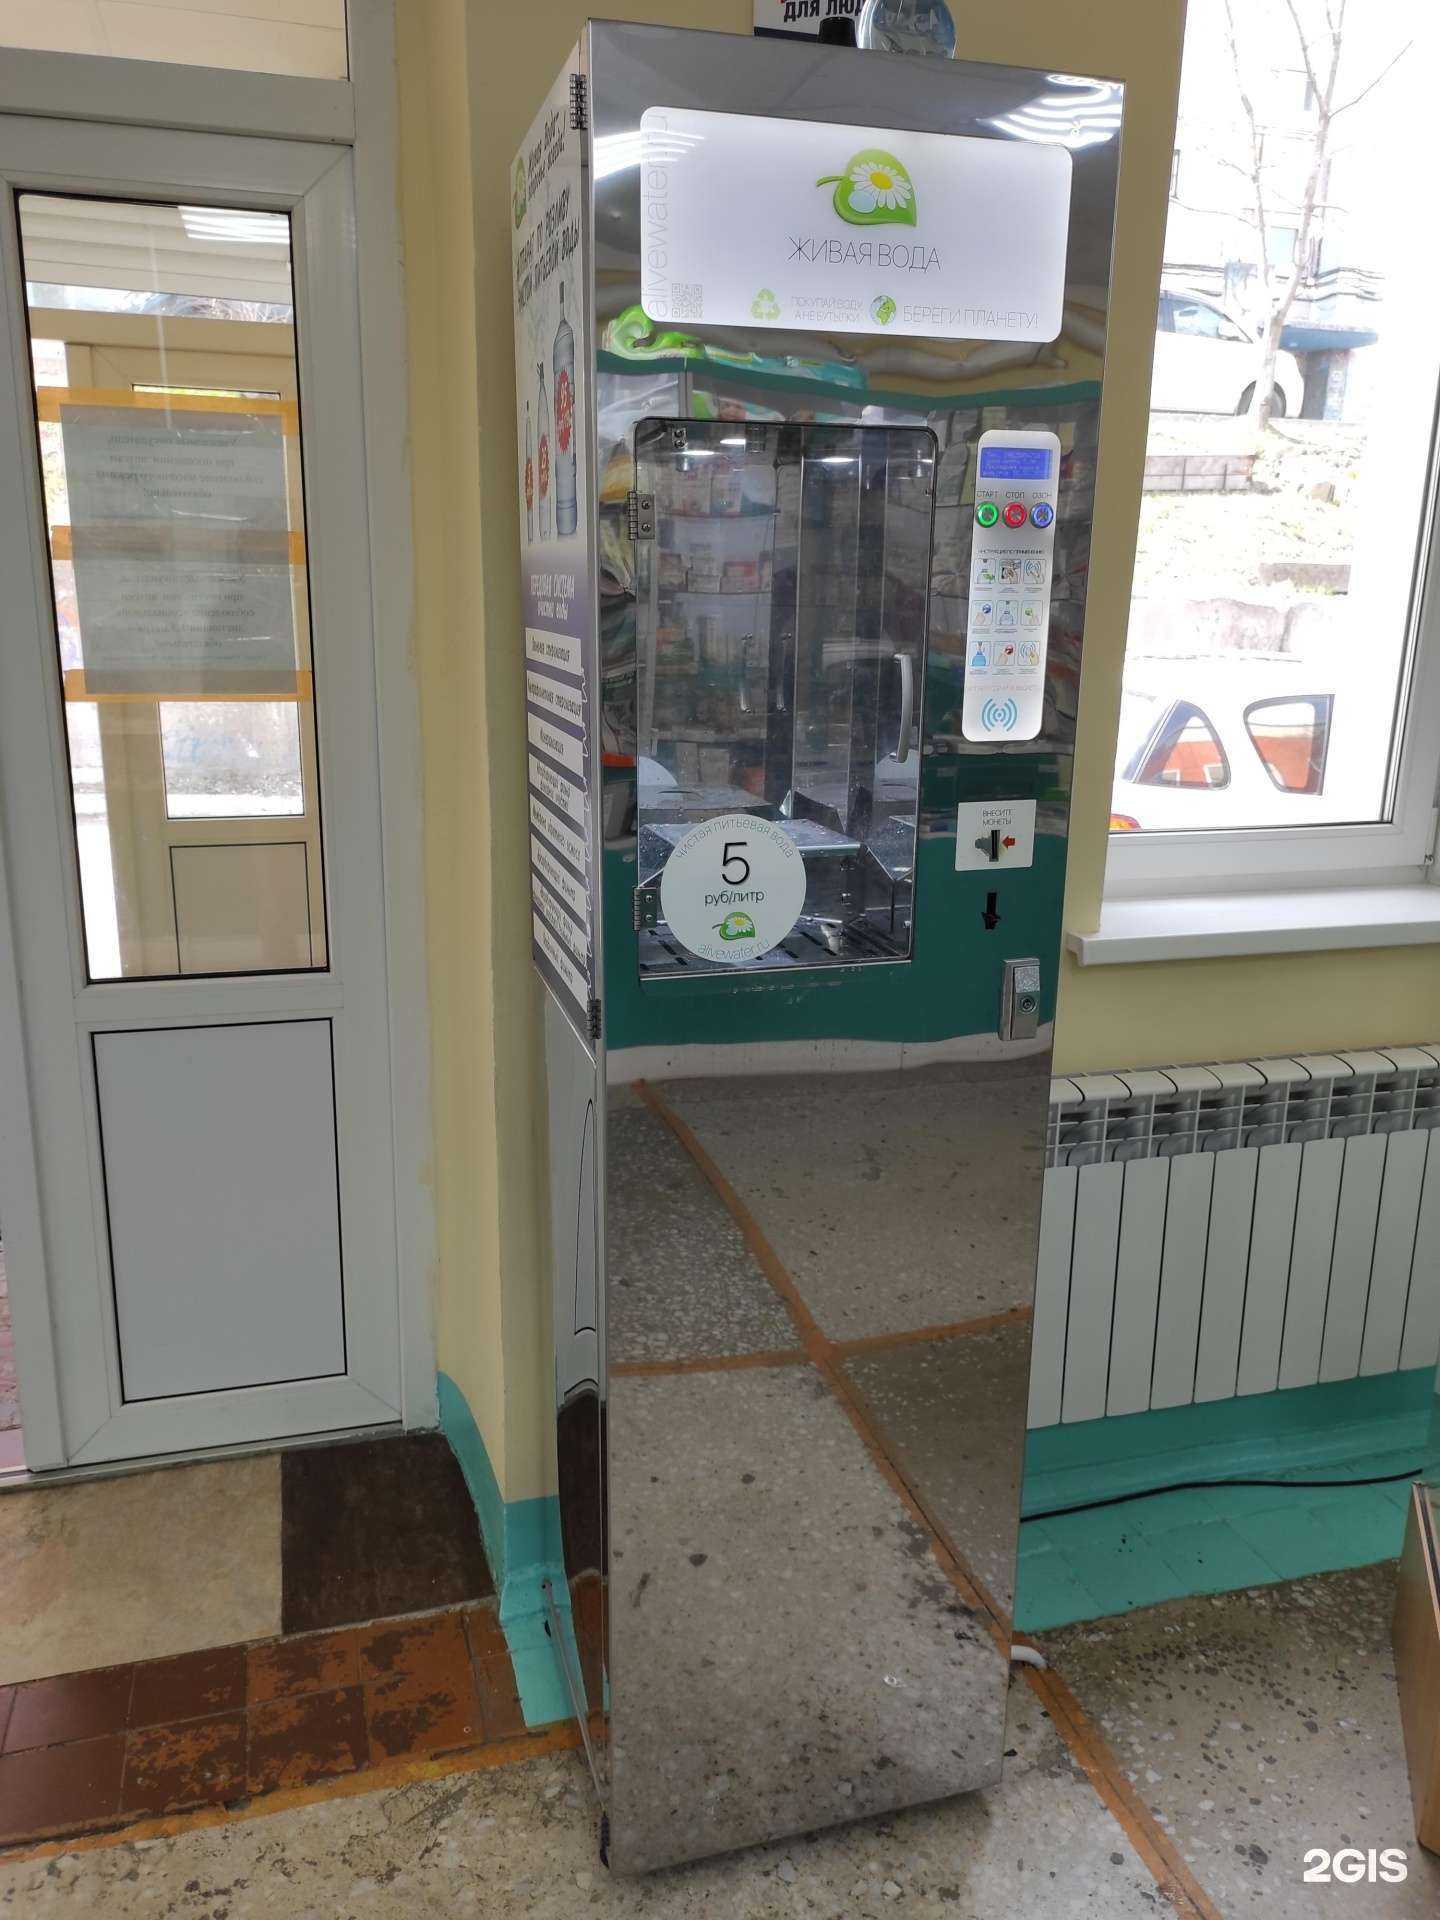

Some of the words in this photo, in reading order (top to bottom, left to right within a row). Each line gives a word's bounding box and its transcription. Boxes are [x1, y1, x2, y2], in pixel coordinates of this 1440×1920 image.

[784, 1, 820, 22] ДЛЯ
[788, 236, 873, 265] ЖИВАЯ
[878, 243, 941, 273] ВОДА
[903, 305, 961, 324] БЕРЕГИ
[965, 309, 1038, 328] ПЛАНЕТУ!
[1006, 491, 1025, 499] СТОП
[676, 823, 712, 858] чистая
[713, 818, 772, 835] питьевая
[771, 831, 795, 858] вода
[721, 841, 751, 886] 5
[704, 889, 766, 907] руб/литр
